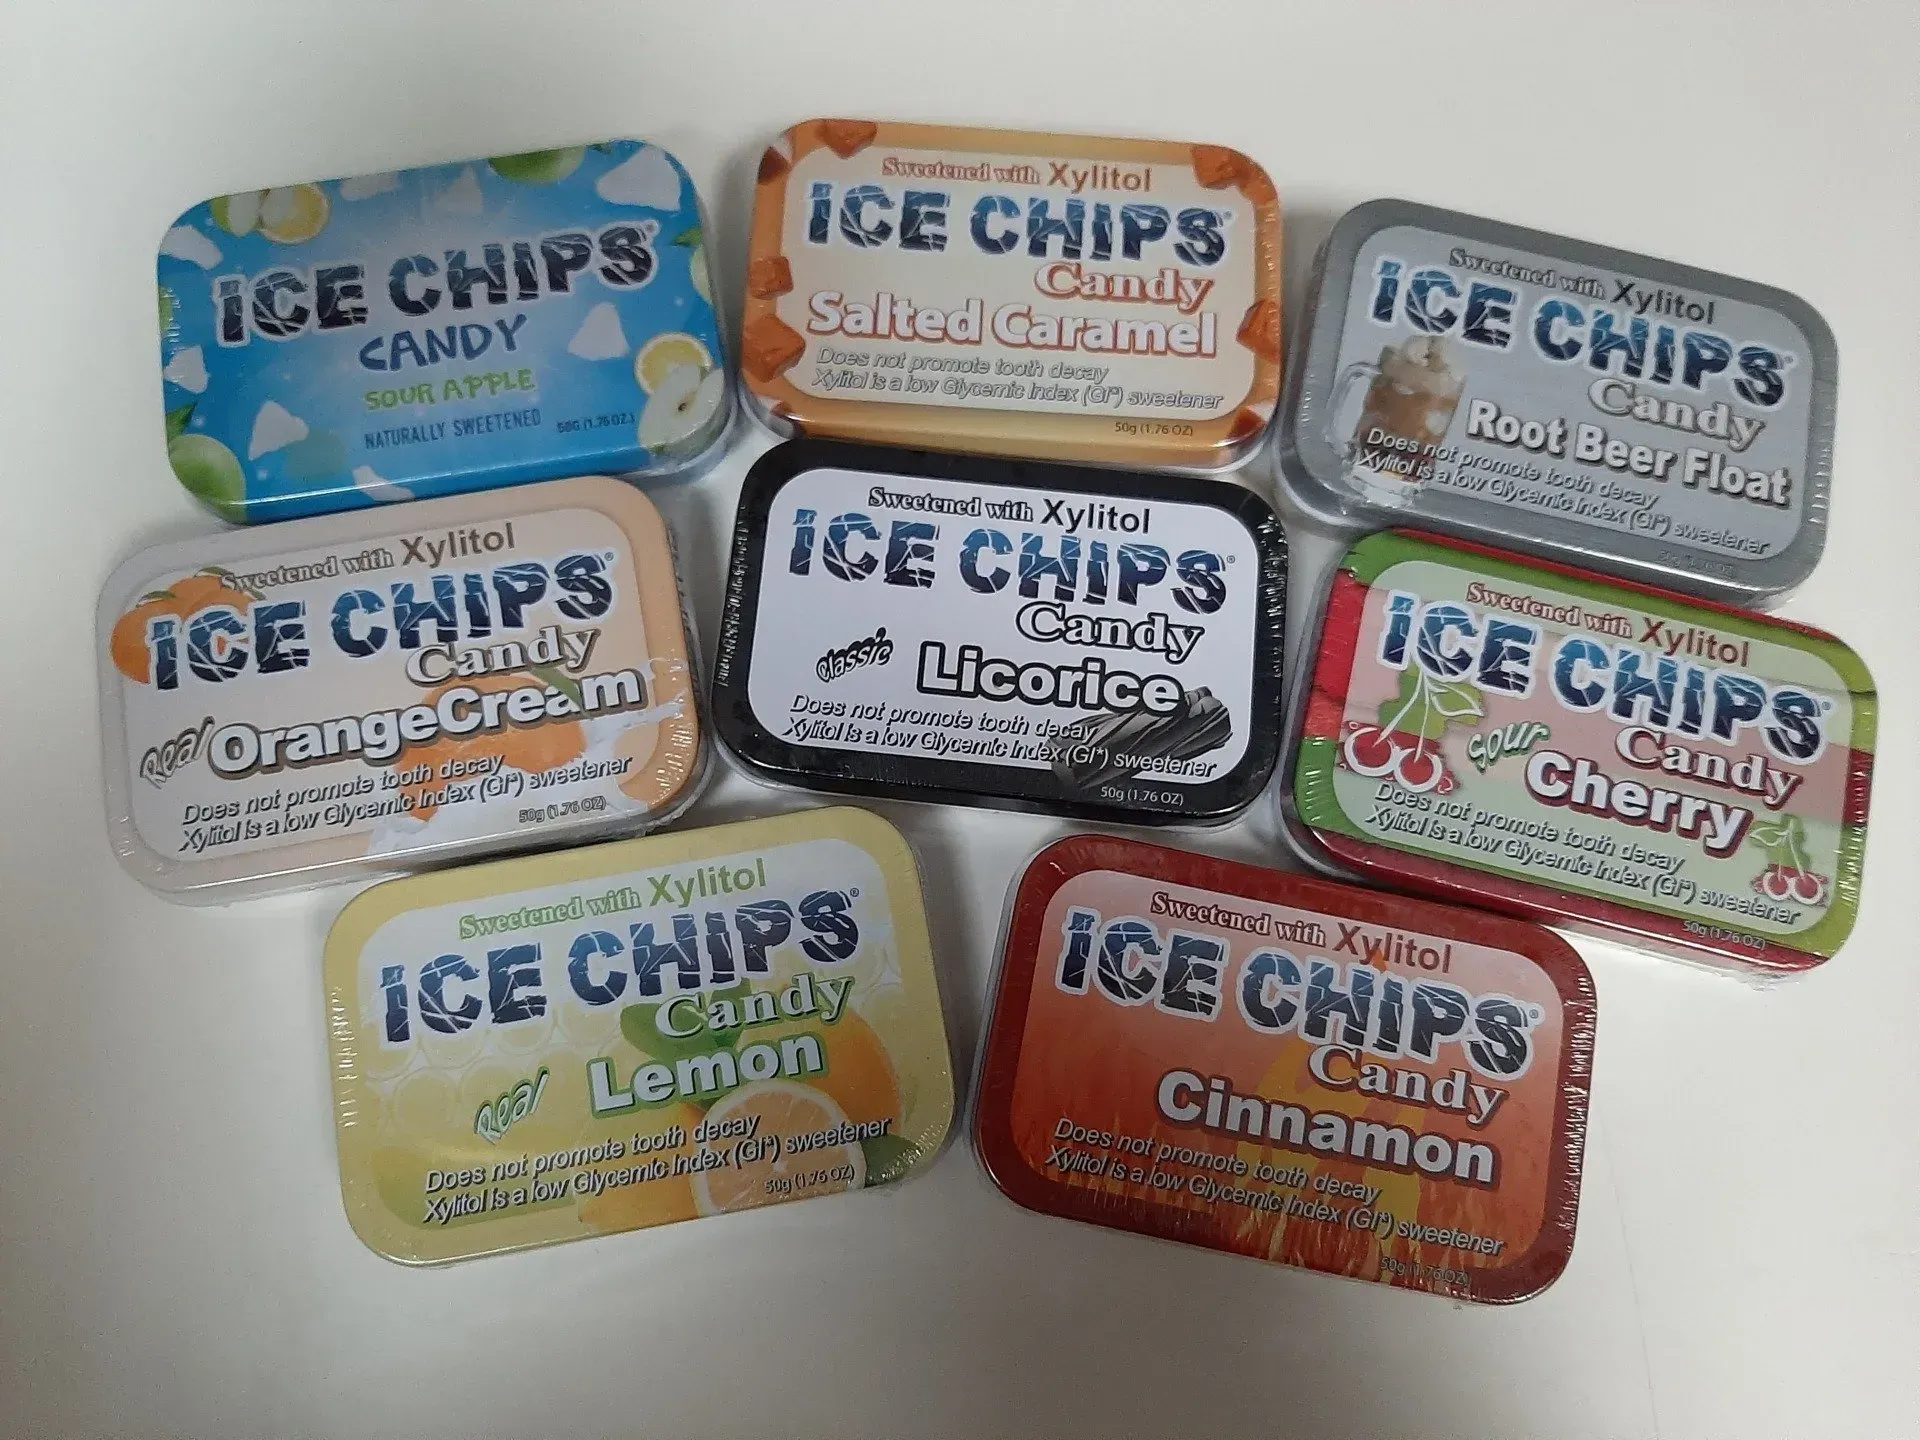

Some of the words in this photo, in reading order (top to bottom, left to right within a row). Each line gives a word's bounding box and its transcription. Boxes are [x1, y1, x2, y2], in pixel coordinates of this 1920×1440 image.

[881, 156, 989, 180] Sweetened
[993, 166, 1039, 184] with
[1046, 162, 1151, 192] Xylitol
[809, 182, 950, 251] ICE
[216, 264, 368, 341] ICE
[387, 224, 656, 317] CHIPS
[1034, 262, 1213, 314] Candy
[1372, 258, 1516, 349] ICE
[1449, 246, 1556, 287] Sweetened
[1560, 276, 1604, 299] with
[1611, 279, 1714, 324] Xylitol
[358, 313, 527, 373] CANDY
[807, 290, 983, 344] Salted
[992, 302, 1215, 357] Caramel
[364, 383, 435, 410] SOUR
[442, 369, 535, 400] APPLE
[811, 369, 867, 389] Xylitol
[905, 375, 936, 393] low
[1027, 383, 1077, 402] Index
[1127, 394, 1223, 409] sweetener
[816, 350, 869, 367] Does
[873, 356, 906, 370] not
[910, 361, 991, 376] promote
[996, 363, 1044, 380] tooth
[1051, 366, 1110, 388] decay
[364, 422, 446, 449] NATURALLY
[454, 408, 542, 437] SWEETENED
[1115, 421, 1137, 435] 50g
[1466, 397, 1563, 456] Root
[1574, 422, 1675, 479] Beer
[1681, 446, 1790, 509] Float
[1587, 378, 1764, 451] Candy
[868, 486, 981, 516] Sweetened
[985, 502, 1032, 521] with
[1040, 499, 1149, 533] Xylitol
[1360, 449, 1417, 476] Xylitol
[1452, 470, 1484, 491] low
[1574, 498, 1624, 524] Index
[1673, 525, 1768, 555] sweetener
[1367, 429, 1420, 455] Does
[1423, 447, 1457, 463] not
[1459, 456, 1540, 483] promote
[1545, 471, 1593, 495] tooth
[1599, 486, 1658, 512] decay
[219, 558, 339, 596] Sweetened
[342, 550, 393, 574] with
[400, 522, 514, 566] Xylitol
[789, 508, 939, 588] ICE
[150, 600, 310, 690] ICE
[405, 624, 600, 687] Candy
[1016, 601, 1204, 663] Candy
[1382, 593, 1537, 694] ICE
[1466, 580, 1580, 626] Sweetened
[1584, 613, 1631, 638] with
[1638, 617, 1750, 666] Xylitol
[915, 641, 1184, 717] Licorice
[140, 717, 213, 787] Real
[209, 667, 645, 774] OrangeCream
[783, 717, 842, 740] Xylitol
[880, 727, 914, 747] low
[1009, 740, 1062, 763] Index
[1114, 756, 1216, 777] sweetener
[790, 694, 845, 716] Does
[848, 704, 883, 720] not
[887, 711, 972, 730] promote
[978, 716, 1028, 736] tooth
[1035, 722, 1097, 747] decay
[180, 820, 240, 850] Xylitol
[284, 813, 317, 832] low
[419, 787, 473, 809] Index
[529, 760, 632, 789] sweetener
[182, 803, 239, 824] Does
[245, 792, 280, 814] not
[287, 779, 374, 812] promote
[381, 767, 433, 791] tooth
[441, 760, 505, 782] decay
[1100, 786, 1124, 801] 50g
[1524, 751, 1753, 852] Cherry
[1614, 727, 1804, 809] Candy
[518, 808, 546, 823] 50g
[1375, 783, 1431, 812] Does
[1434, 803, 1469, 821] not
[1472, 813, 1558, 844] promote
[1563, 831, 1614, 858] tooth
[1621, 848, 1684, 876] decay
[458, 897, 583, 940] Sweetened
[586, 889, 640, 916] with
[646, 858, 766, 907] Xylitol
[1366, 806, 1427, 836] Xylitol
[1464, 829, 1498, 853] low
[1593, 860, 1648, 890] Index
[1699, 892, 1802, 926] sweetener
[1060, 909, 1224, 1016] ICE
[1149, 889, 1272, 935] Sweetened
[1276, 920, 1326, 947] with
[1334, 922, 1452, 973] Xylitol
[378, 942, 549, 1043] ICE
[655, 972, 855, 1039] Candy
[475, 1066, 548, 1143] Real
[586, 1031, 828, 1117] Lemon
[1307, 1044, 1510, 1126] Candy
[426, 1170, 484, 1194] Does
[491, 1158, 527, 1182] not
[535, 1143, 624, 1180] promote
[631, 1129, 685, 1157] tooth
[694, 1121, 759, 1146] decay
[1054, 1121, 1113, 1150] Does
[1116, 1140, 1154, 1158] not
[1156, 1150, 1247, 1179] promote
[1253, 1164, 1306, 1192] tooth
[1313, 1179, 1378, 1209] decay
[1158, 1070, 1494, 1185] Cinnamon
[424, 1189, 486, 1223] Xylitol
[533, 1181, 566, 1203] low
[673, 1152, 728, 1176] Index
[787, 1121, 892, 1154] sweetener
[765, 1178, 792, 1194] 50g
[1046, 1146, 1109, 1177] Xylitol
[1149, 1166, 1184, 1192] low
[1284, 1195, 1341, 1225] Index
[1395, 1224, 1501, 1256] sweetener
